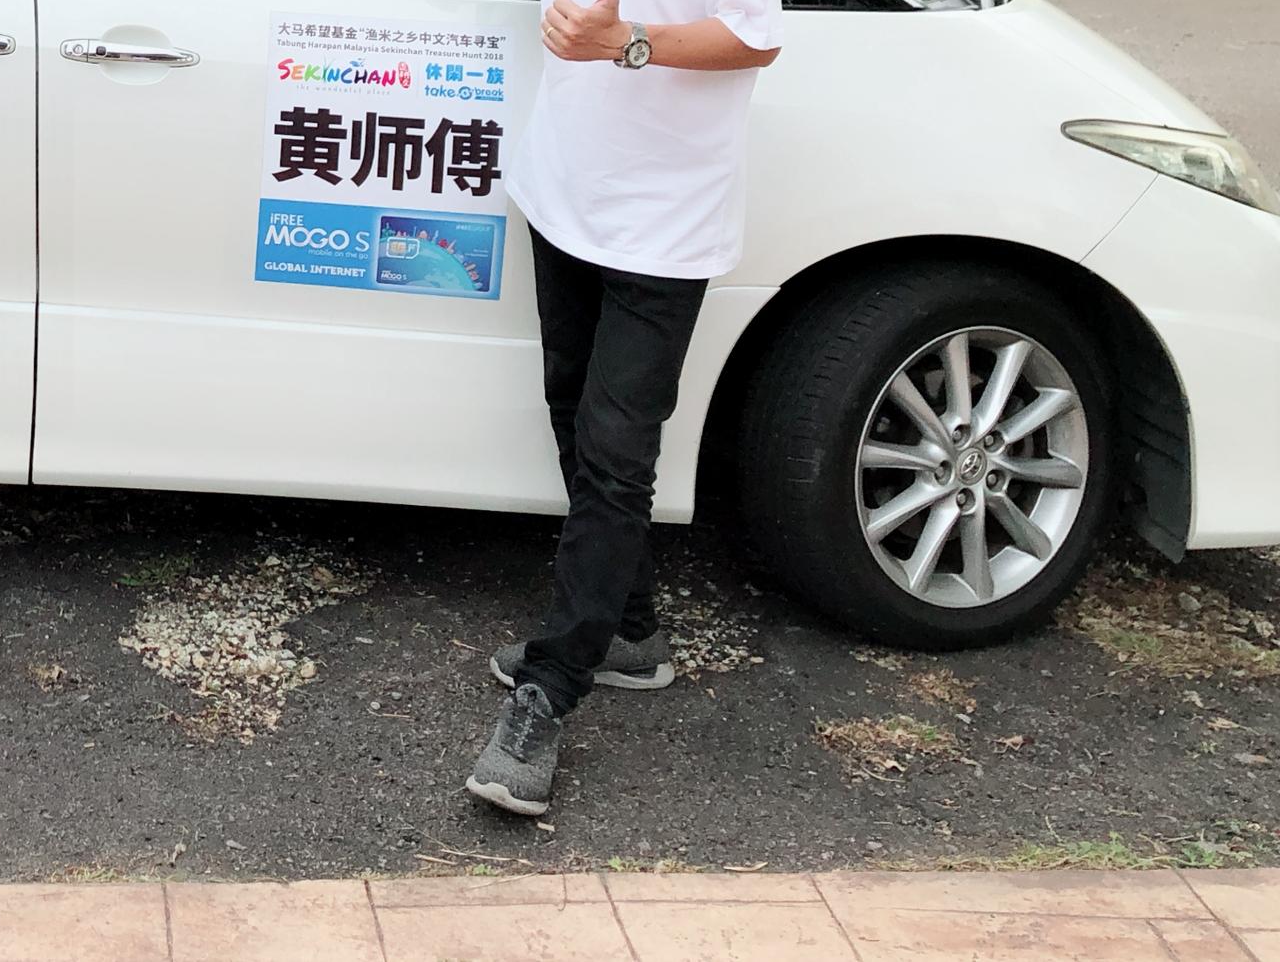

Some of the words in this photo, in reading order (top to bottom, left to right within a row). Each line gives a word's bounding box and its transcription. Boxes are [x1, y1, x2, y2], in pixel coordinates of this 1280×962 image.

[277, 39, 306, 49] Tabung
[308, 41, 342, 51] Harapan
[344, 43, 378, 53] Malaysia
[381, 46, 423, 55] Sekinchan
[425, 49, 460, 58] Treasure
[462, 51, 482, 59] Hunt
[278, 58, 396, 87] SEKINCHAN
[424, 85, 455, 98] take
[474, 87, 504, 96] break
[272, 106, 504, 197] 黄师傅
[270, 212, 304, 226] iFREE
[264, 225, 350, 250] MOGO
[354, 231, 370, 252] S
[264, 261, 308, 273] GLOBAL
[309, 264, 366, 278] INTERNET
